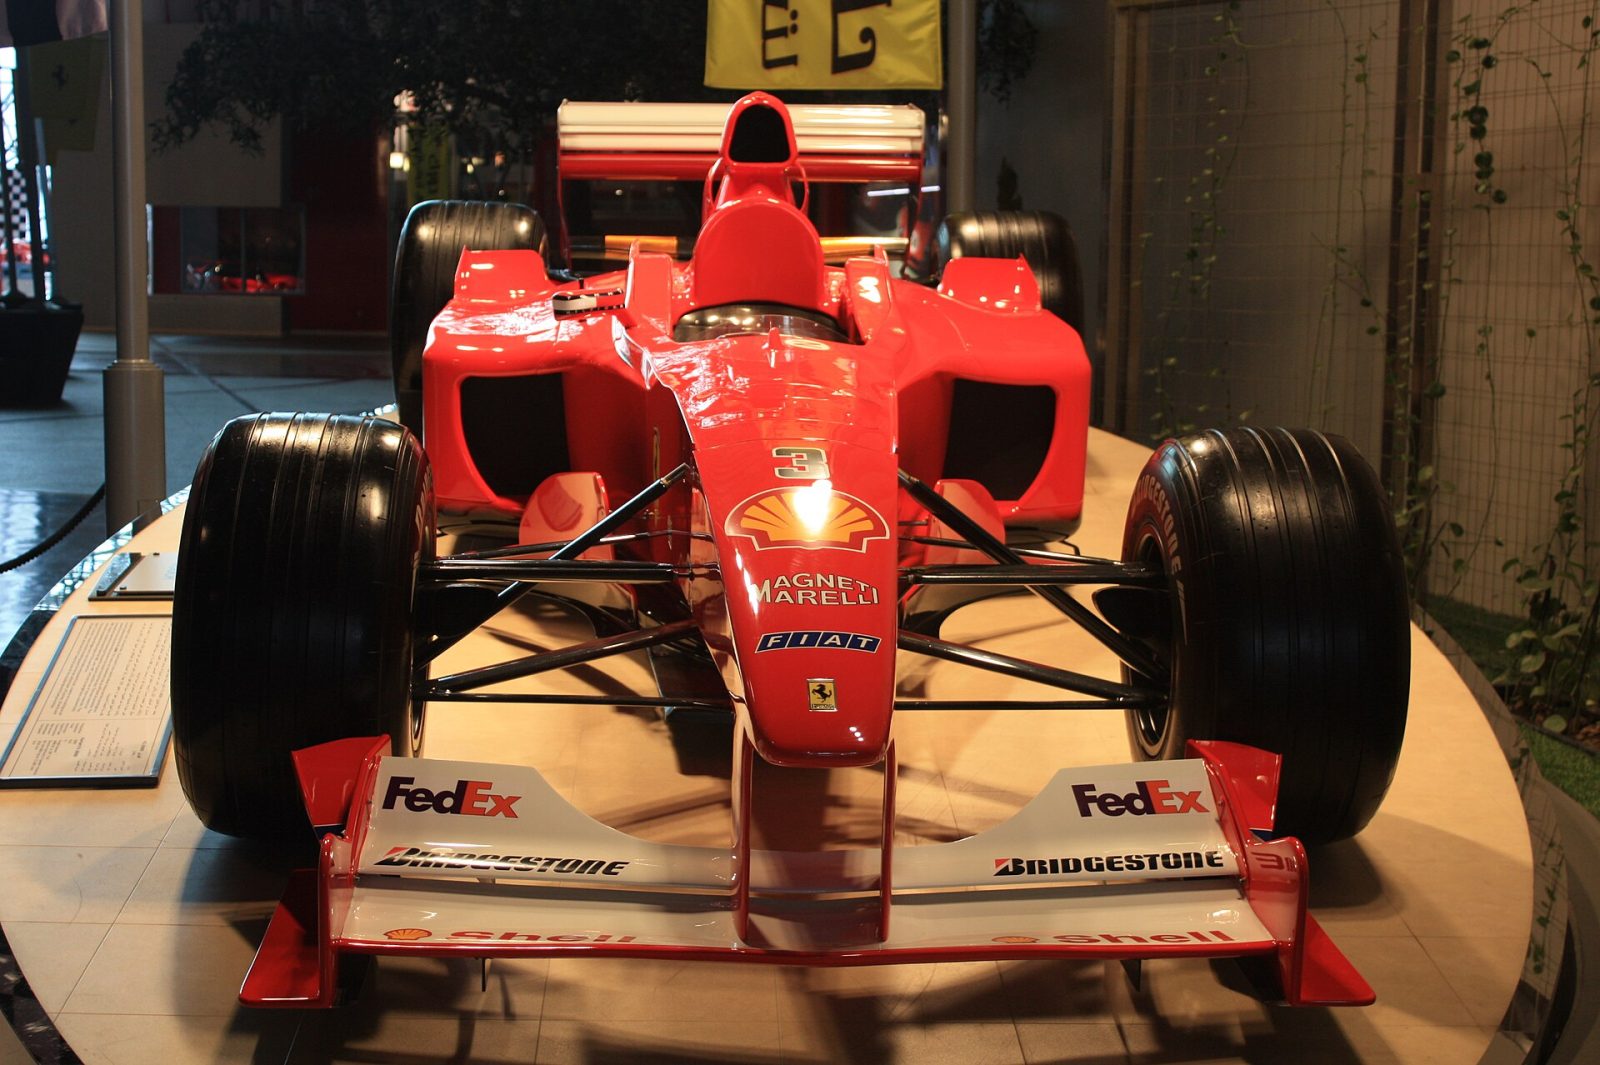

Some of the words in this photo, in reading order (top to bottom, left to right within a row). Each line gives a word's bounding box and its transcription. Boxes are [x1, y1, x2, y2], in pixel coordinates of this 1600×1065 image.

[772, 446, 831, 480] 3
[754, 573, 880, 599] MAGNETI
[754, 581, 880, 606] MARELLI
[763, 633, 875, 650] FIAT
[381, 776, 523, 819] FedEx
[1071, 779, 1211, 818] FedEx
[373, 846, 630, 876] BRIDGESTONE
[993, 850, 1225, 877] BRIDGESTONE
[445, 931, 637, 943] Shell
[1053, 930, 1236, 944] Shell
